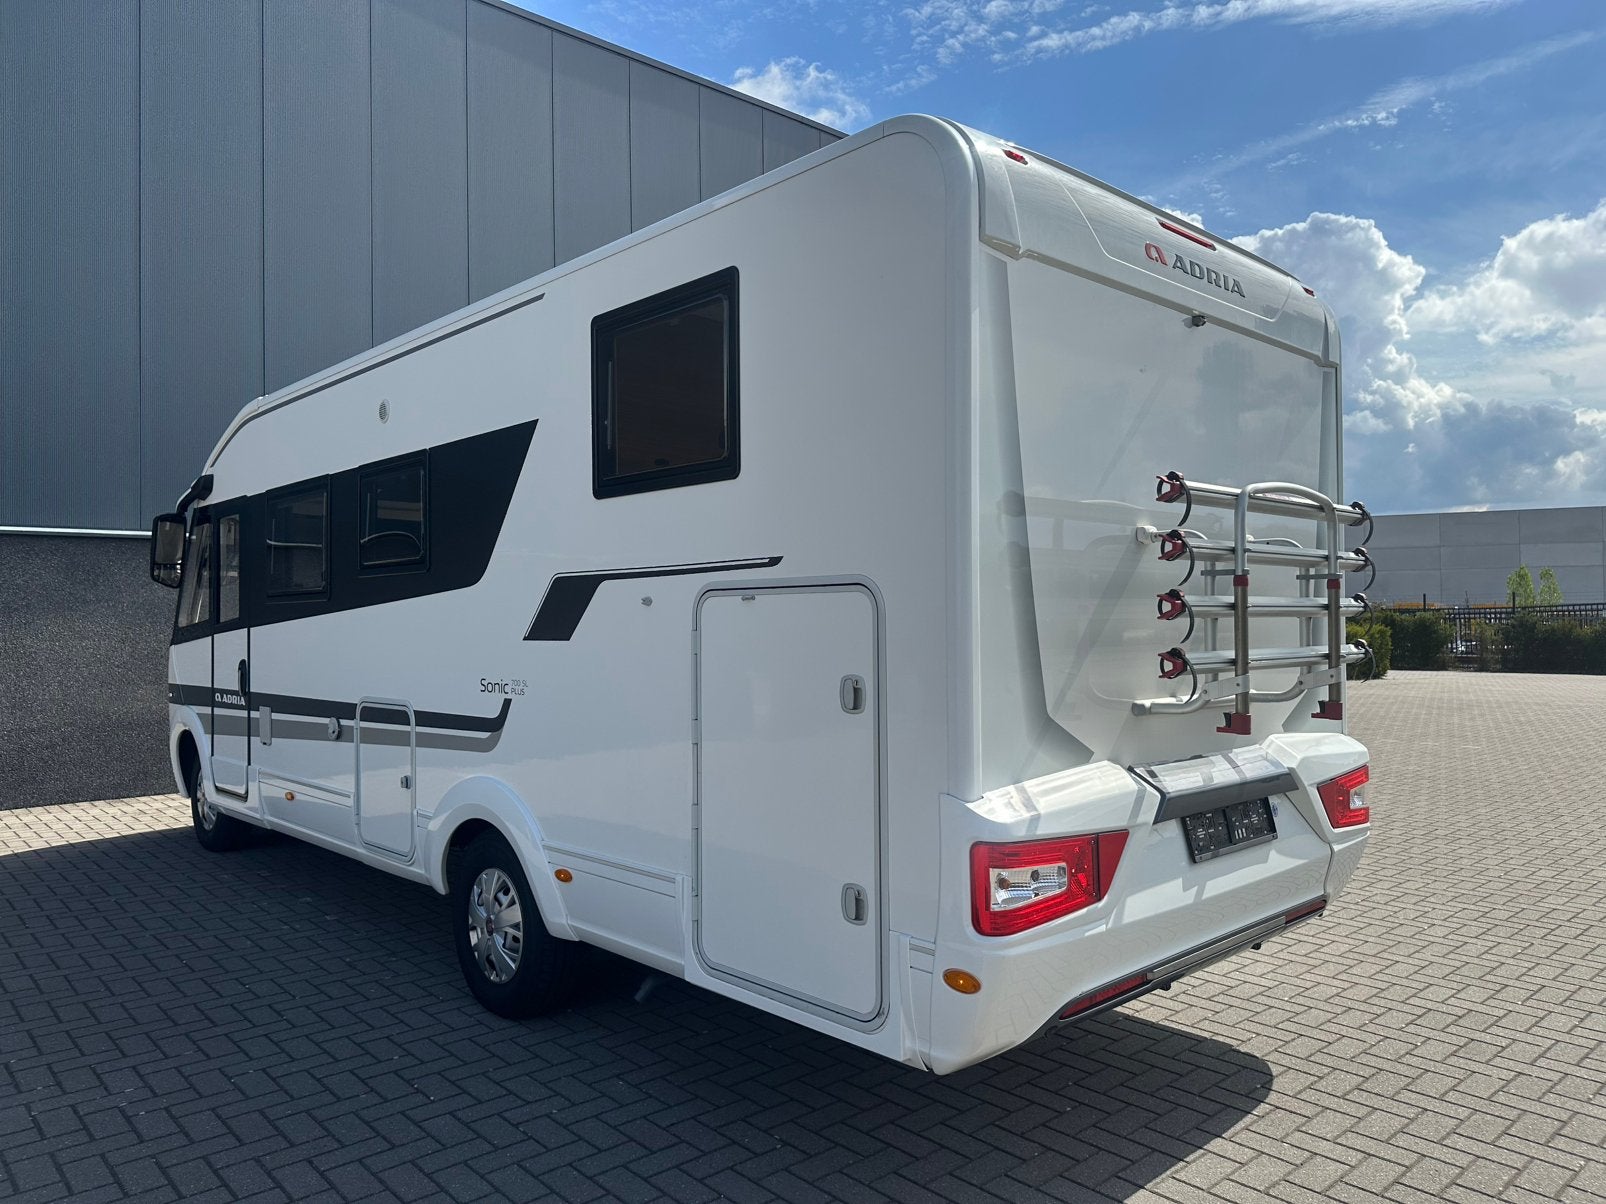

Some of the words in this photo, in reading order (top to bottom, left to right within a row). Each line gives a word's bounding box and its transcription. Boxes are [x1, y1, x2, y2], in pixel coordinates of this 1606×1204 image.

[1172, 253, 1246, 298] ADRIA
[480, 678, 509, 694] Sonic
[511, 688, 525, 696] PLUS
[222, 694, 246, 706] ADRIA
